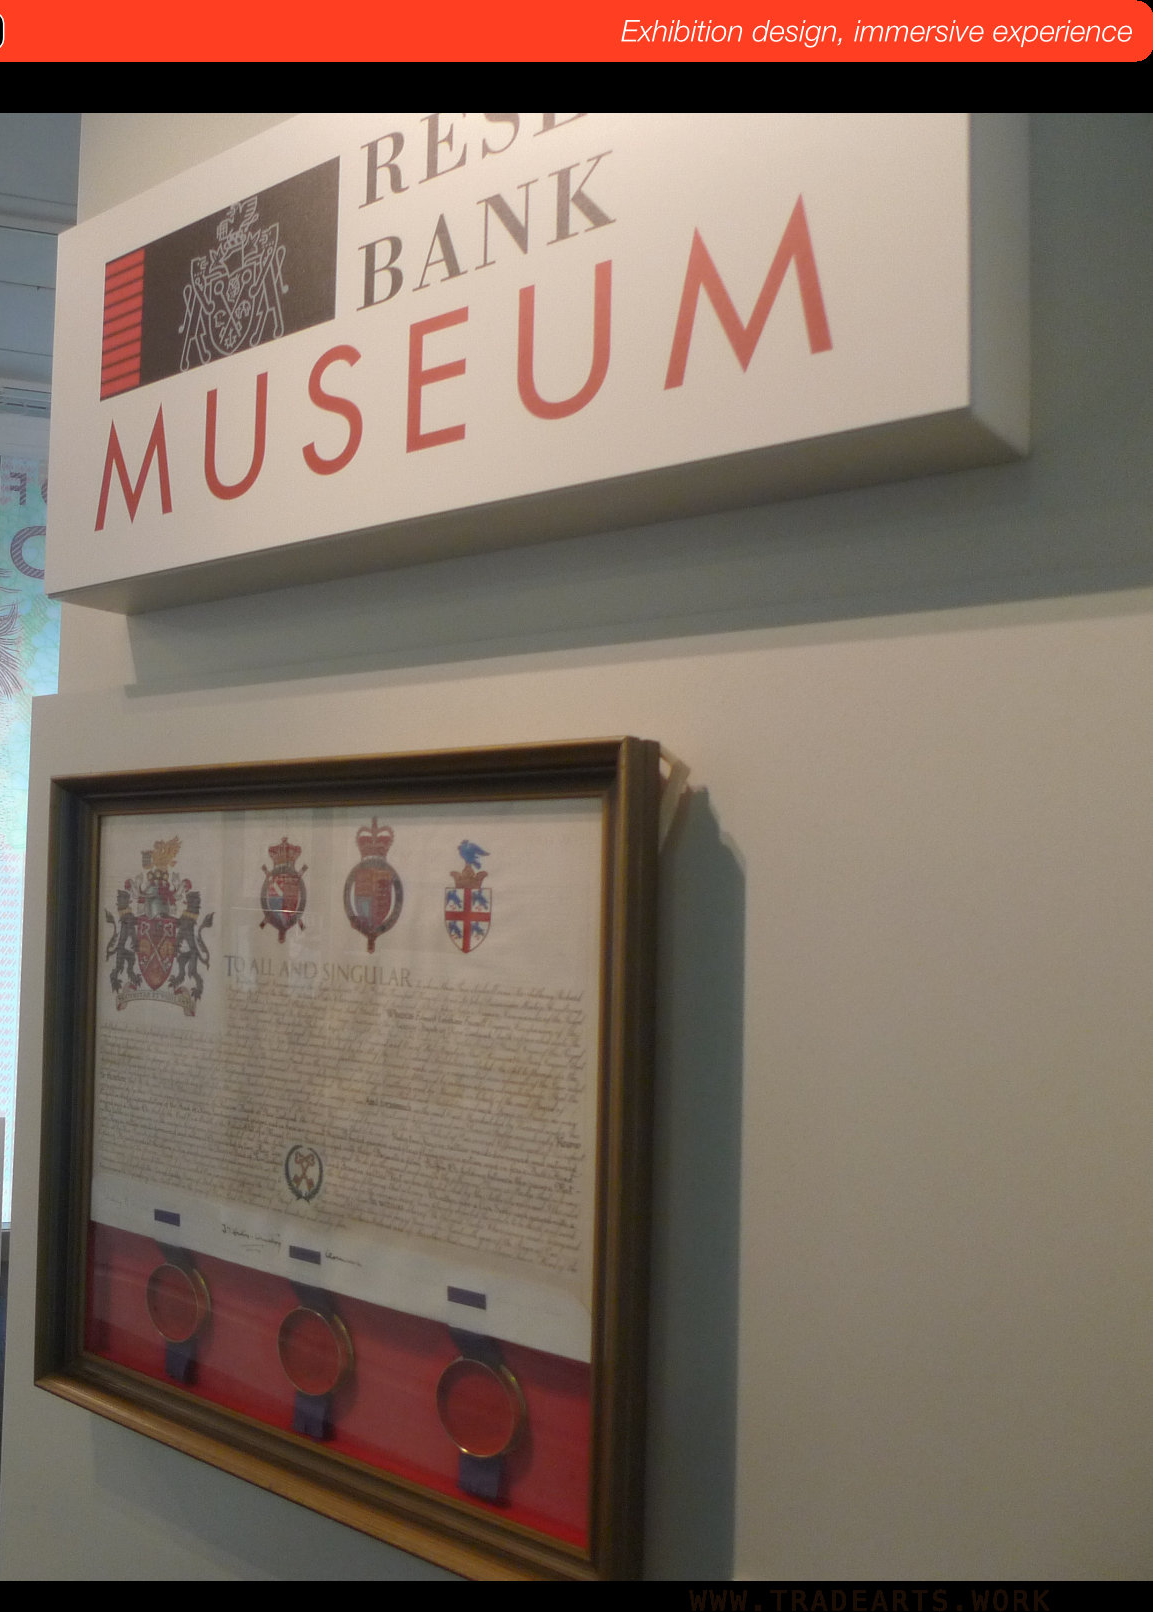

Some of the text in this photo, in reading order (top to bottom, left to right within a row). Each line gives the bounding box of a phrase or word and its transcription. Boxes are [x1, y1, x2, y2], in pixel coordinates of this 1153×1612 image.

[356, 150, 617, 311] BANK
[94, 194, 834, 532] MUSEUM
[250, 957, 275, 977] ALL
[279, 960, 318, 980] AND
[322, 962, 413, 988] SINGULAR
